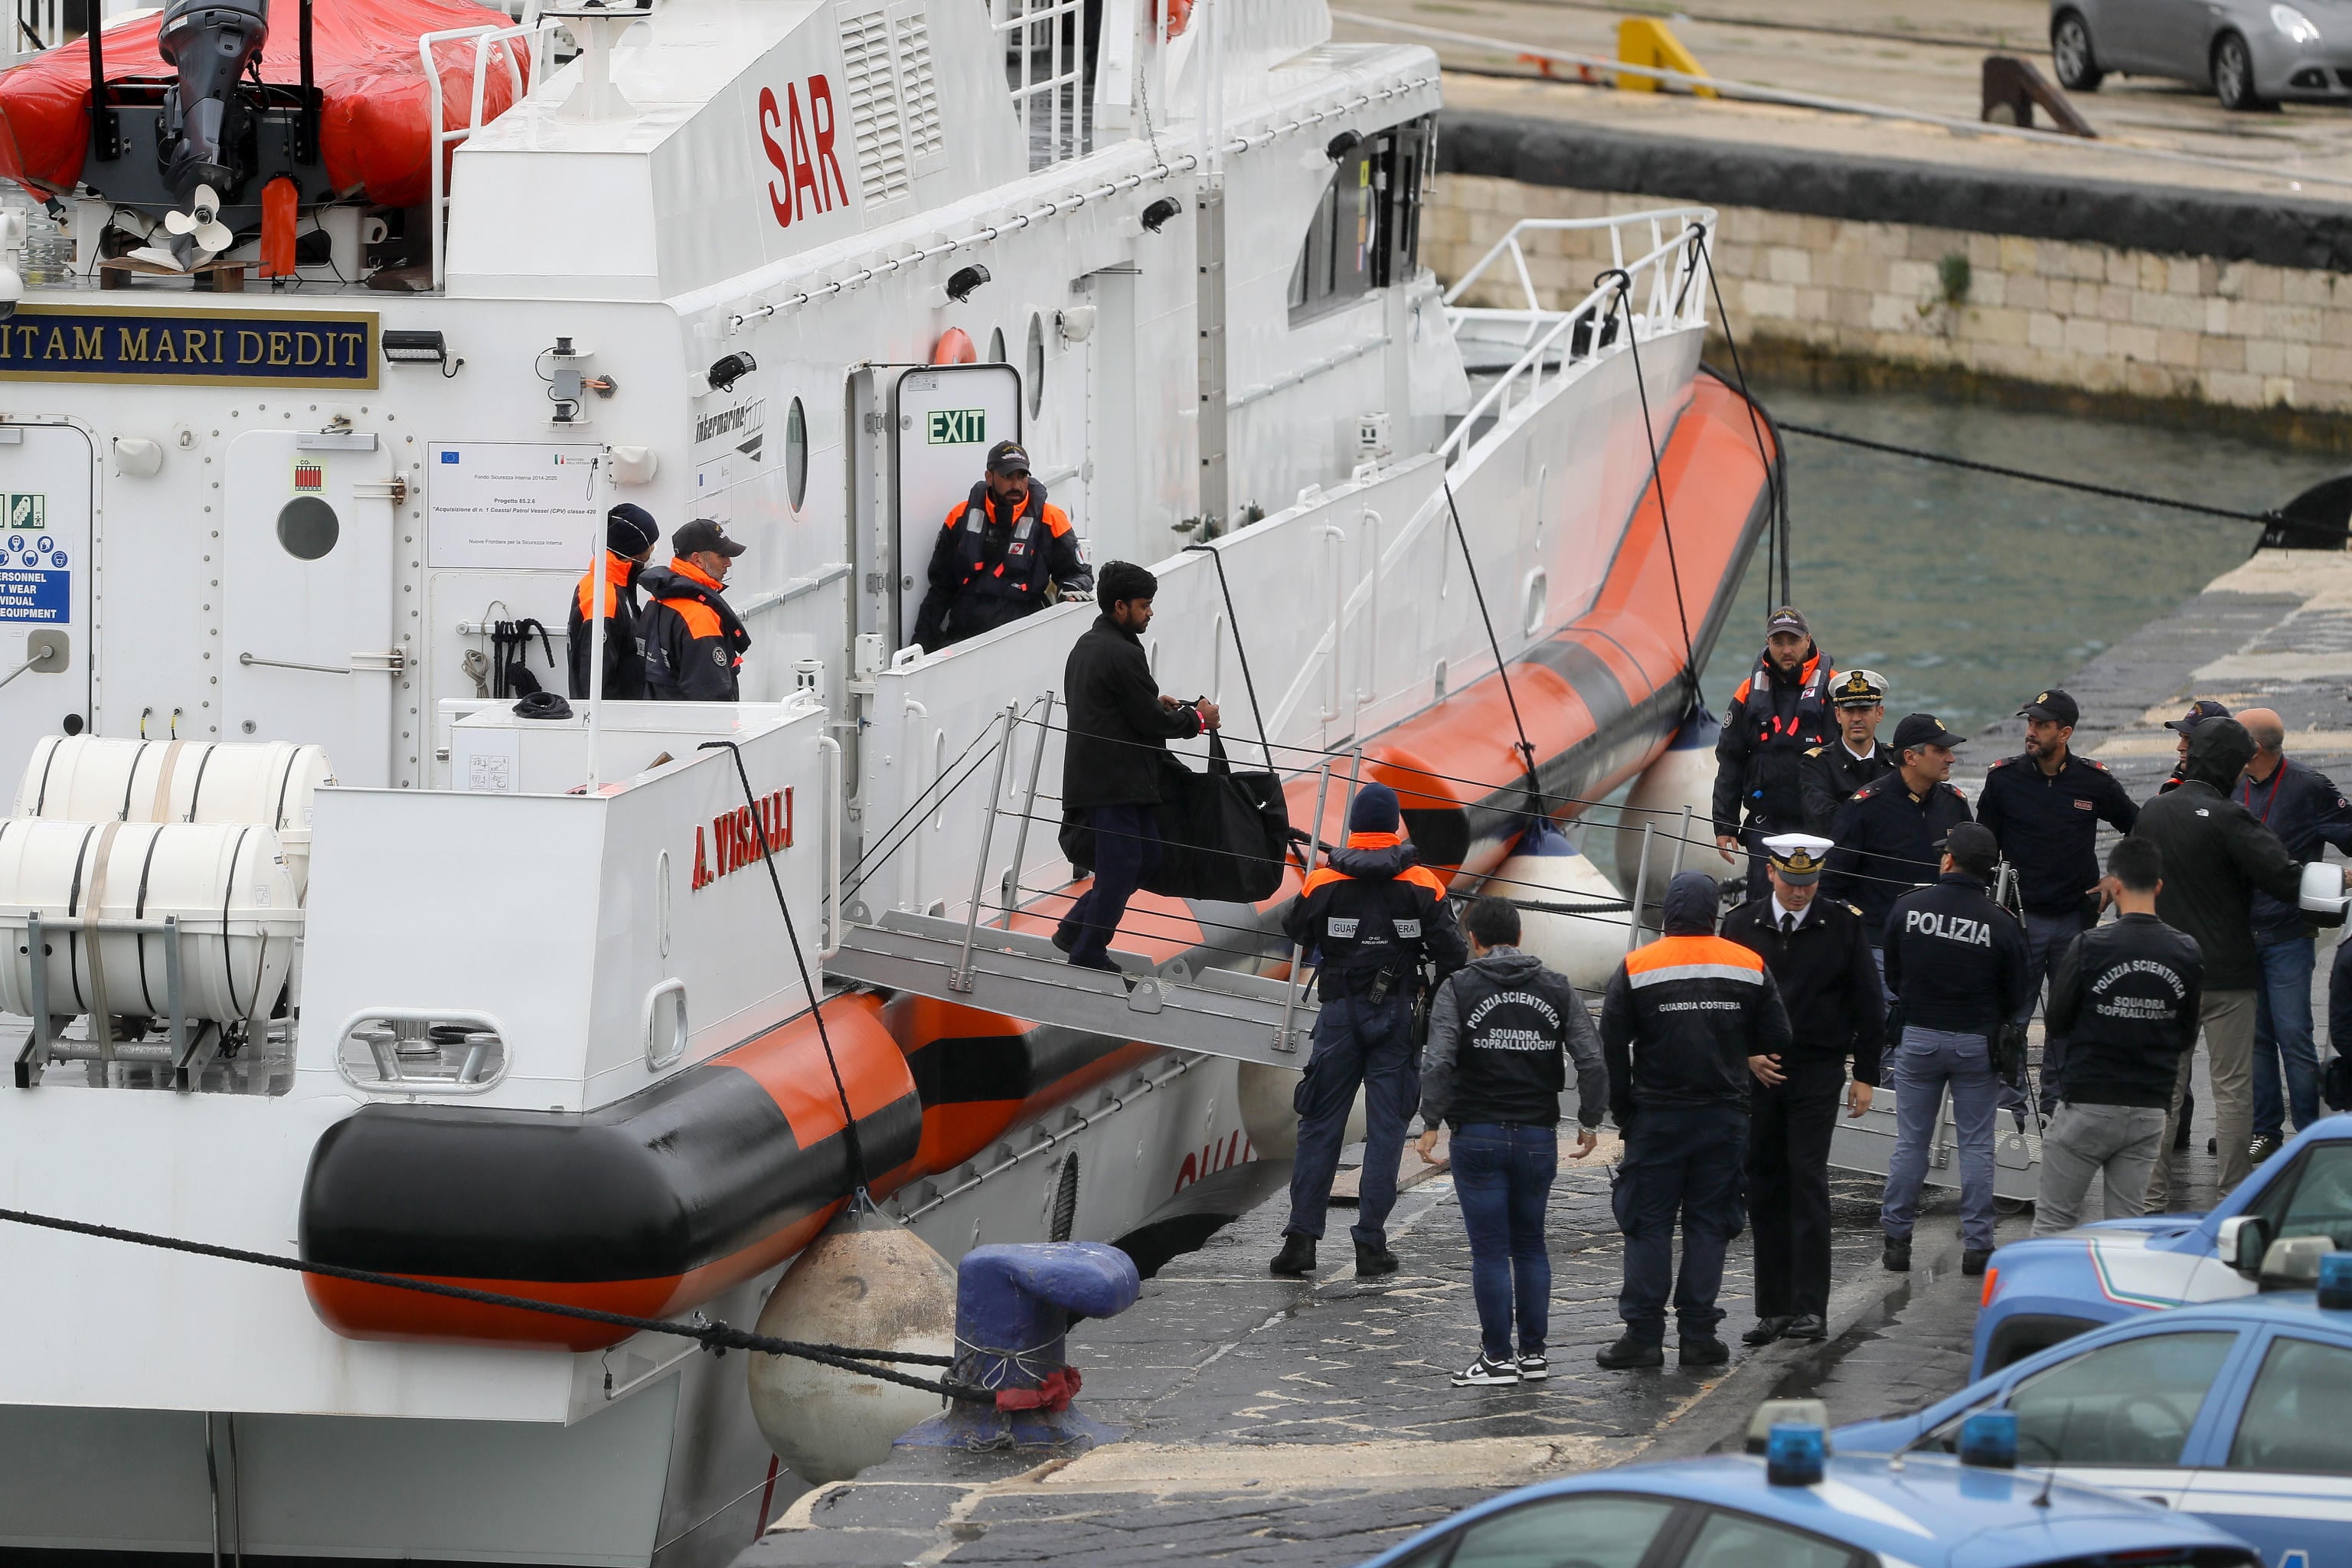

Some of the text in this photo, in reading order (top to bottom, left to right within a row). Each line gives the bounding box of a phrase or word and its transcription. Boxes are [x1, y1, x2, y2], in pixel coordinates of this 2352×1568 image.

[759, 74, 849, 227] SAR
[118, 328, 224, 364] MARI
[237, 330, 362, 367] DEDIT
[694, 400, 745, 444] intermarine
[929, 410, 984, 443] EXIT
[0, 572, 47, 583] RSONNEL
[8, 584, 37, 594] WEAR
[0, 596, 34, 606] VIDUAL
[0, 607, 57, 619] EQUIPMENT
[692, 785, 795, 890] A. VISALLI
[1334, 923, 1358, 933] GUAR
[1906, 910, 1991, 948] POLIZIA
[2092, 960, 2186, 999] POLIZIA SCIENTIFICA
[1467, 991, 1561, 1029] POLIZIA SCIENTIFICA
[1658, 1001, 1741, 1011] GUARDIA COSTIERA
[2114, 996, 2165, 1010] SQUADRA
[2096, 1004, 2177, 1020] SOPRALLUOGHI
[1489, 1028, 1540, 1040] SQUADRA
[1472, 1038, 1556, 1050] SOPRALLUOGHI
